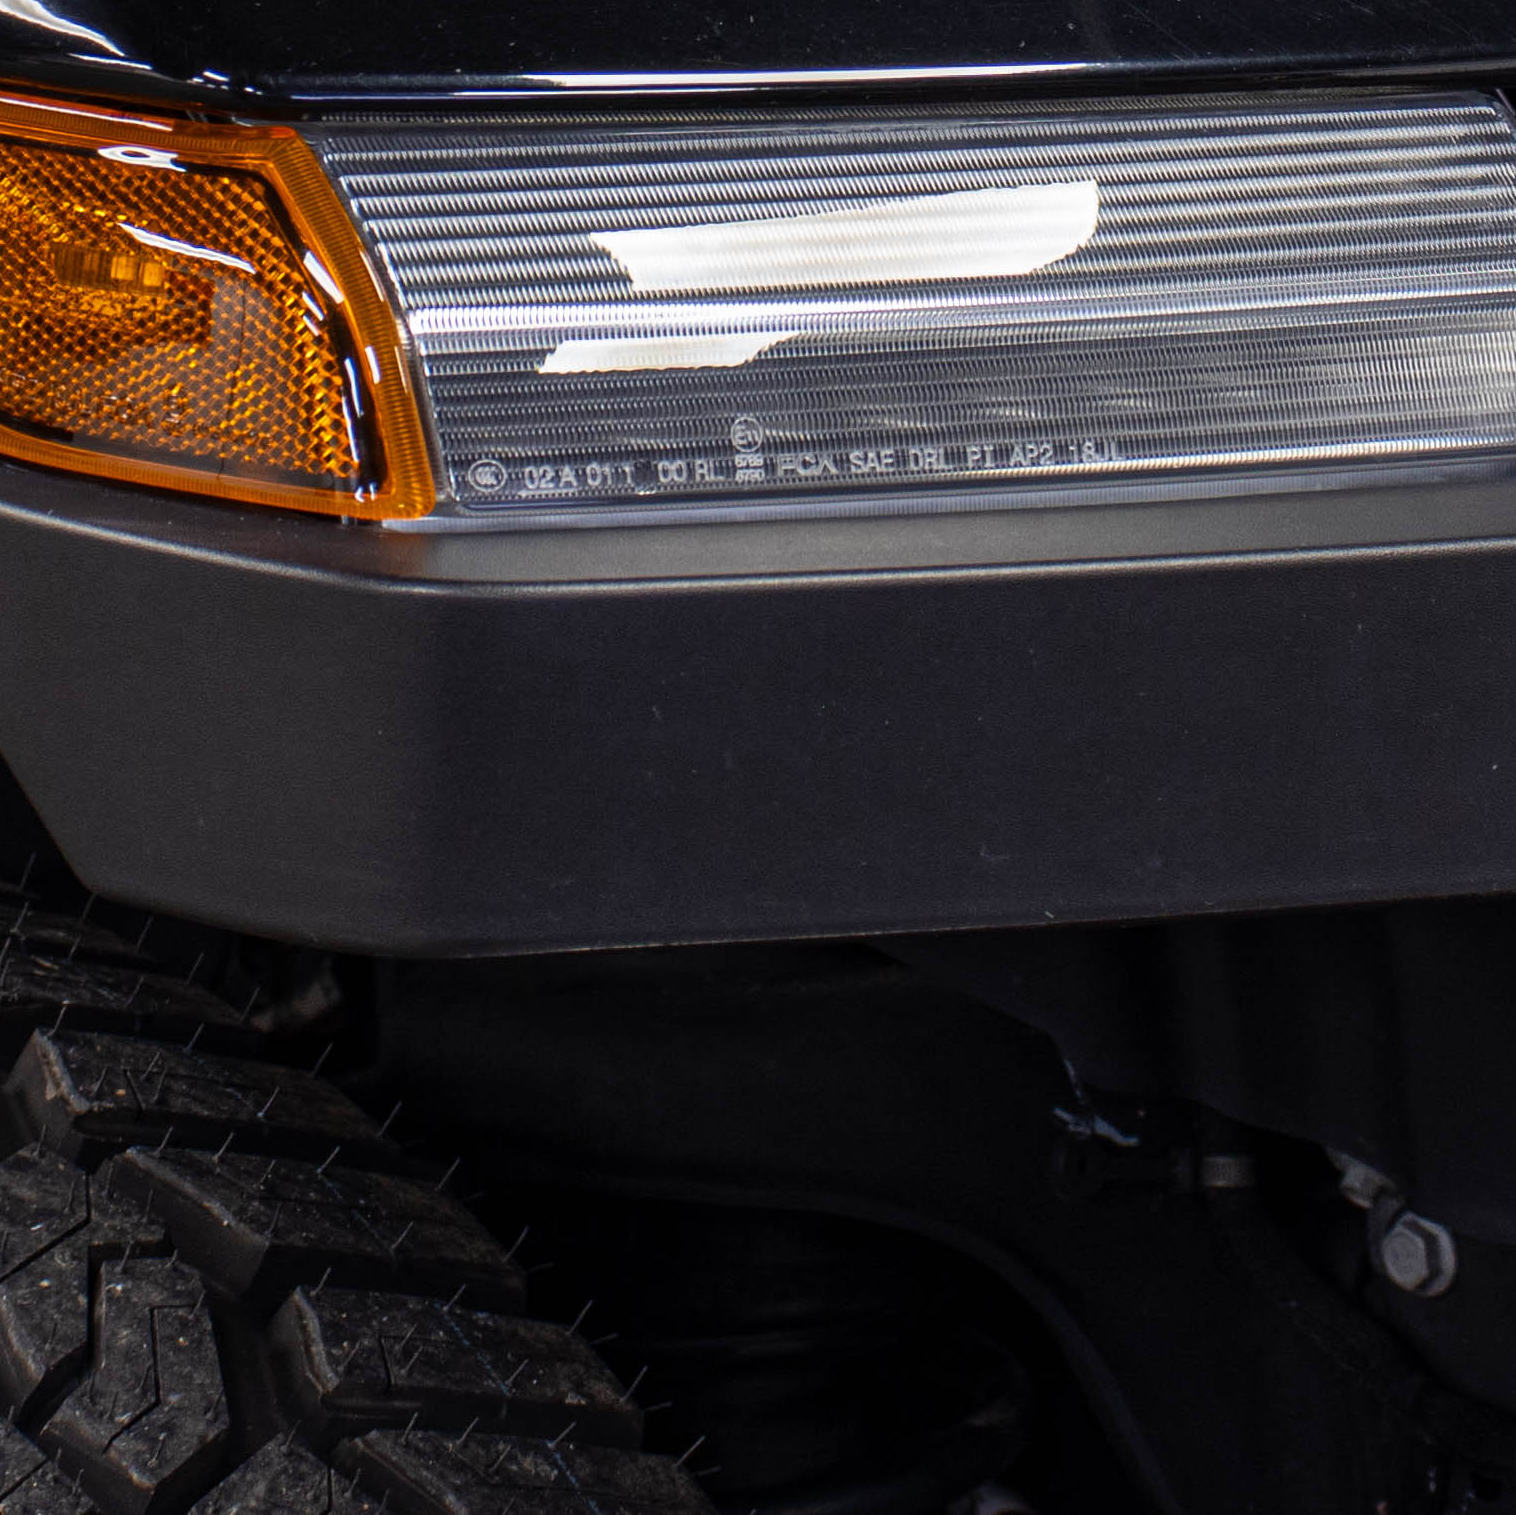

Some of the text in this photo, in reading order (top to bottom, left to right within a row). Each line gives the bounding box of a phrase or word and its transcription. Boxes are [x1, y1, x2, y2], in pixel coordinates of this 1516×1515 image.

[523, 465, 555, 488] 02
[560, 464, 577, 487] A
[657, 460, 687, 482] 00
[694, 459, 725, 481] RL
[776, 453, 837, 476] FCA
[849, 450, 894, 472] SAE
[909, 447, 954, 470] DRL
[1010, 443, 1054, 466] AP2
